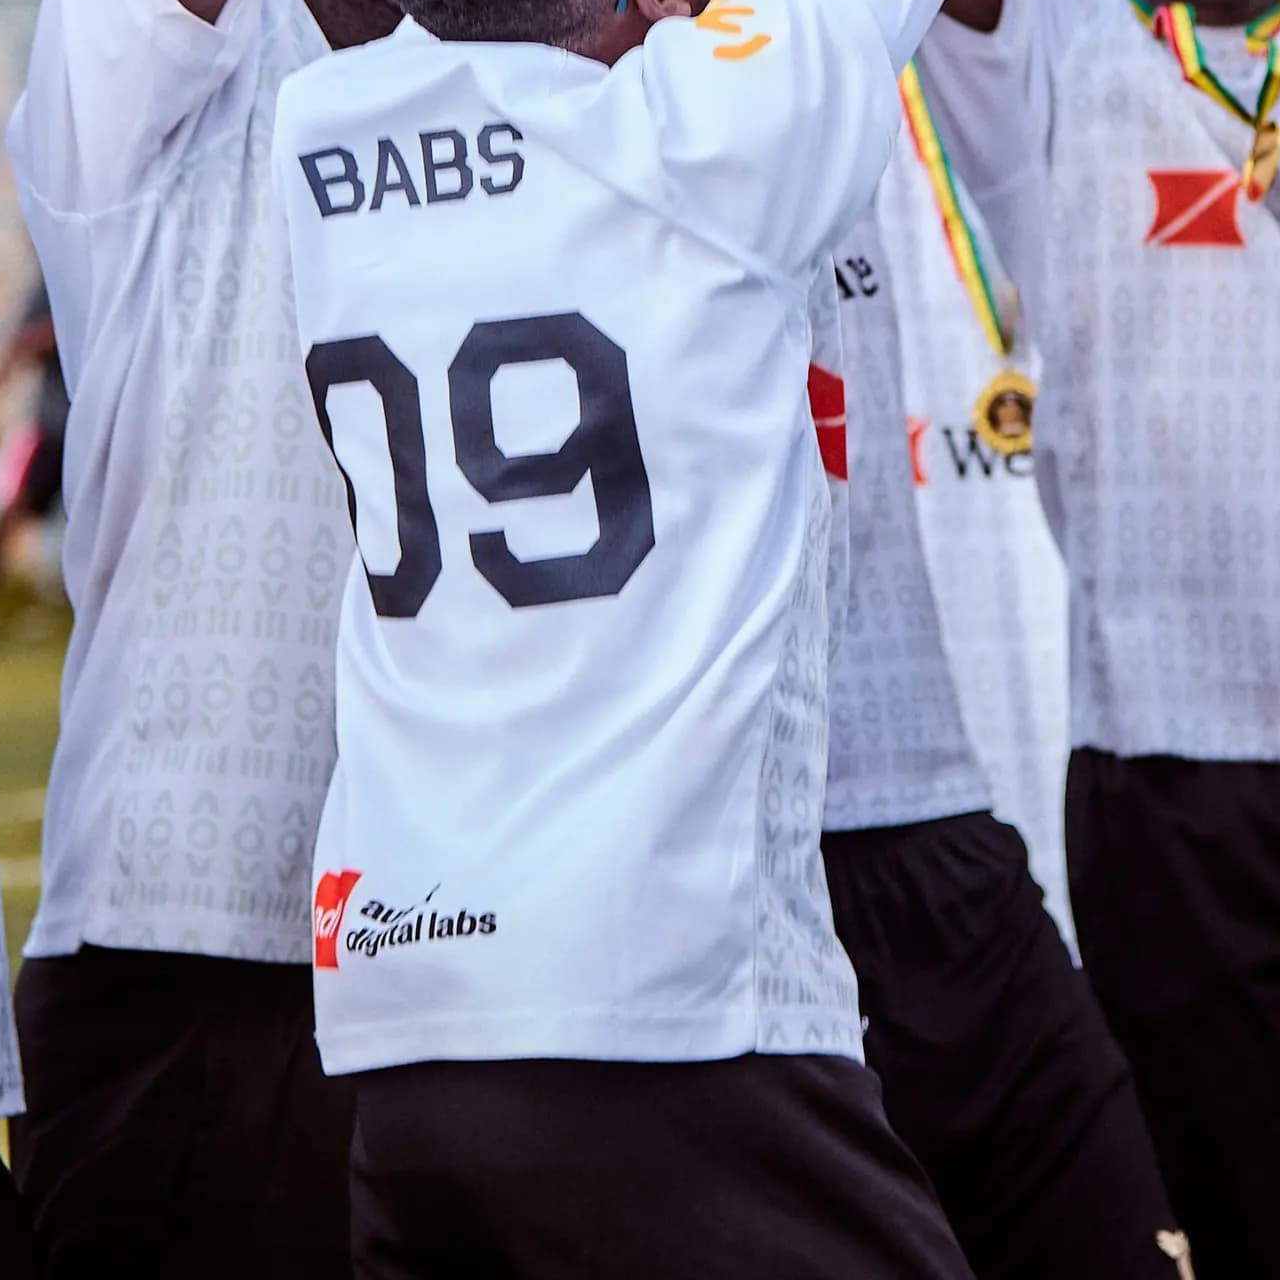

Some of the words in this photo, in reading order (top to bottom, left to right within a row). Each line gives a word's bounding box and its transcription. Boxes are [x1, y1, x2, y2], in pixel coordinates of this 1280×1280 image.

[298, 123, 525, 217] BABS
[305, 311, 657, 618] 09
[428, 908, 497, 941] labs
